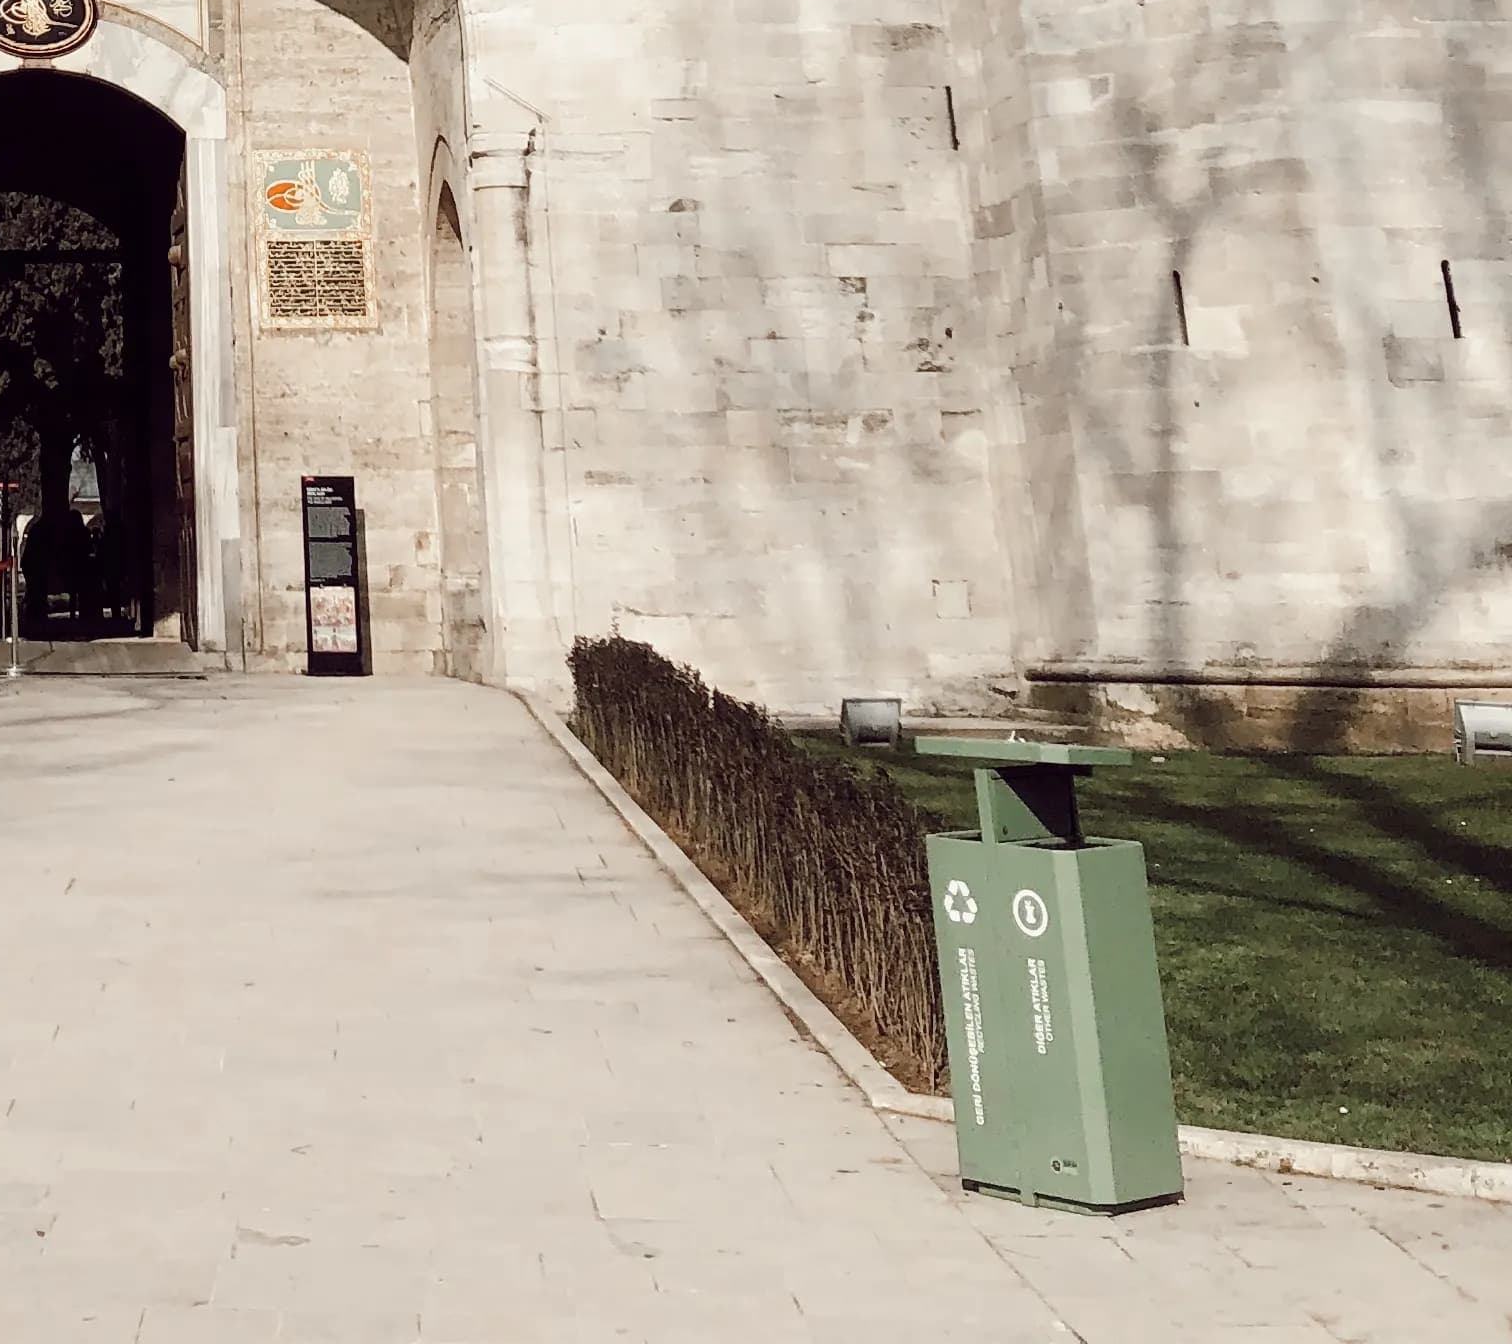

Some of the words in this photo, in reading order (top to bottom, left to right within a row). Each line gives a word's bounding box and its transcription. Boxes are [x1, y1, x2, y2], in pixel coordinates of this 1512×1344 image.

[958, 947, 972, 1002] ATIKLAR
[967, 948, 979, 992] WASTES
[1028, 957, 1042, 1013] ATIKLAR
[1037, 959, 1049, 1003] WASTES
[1041, 1005, 1054, 1042] OTHER
